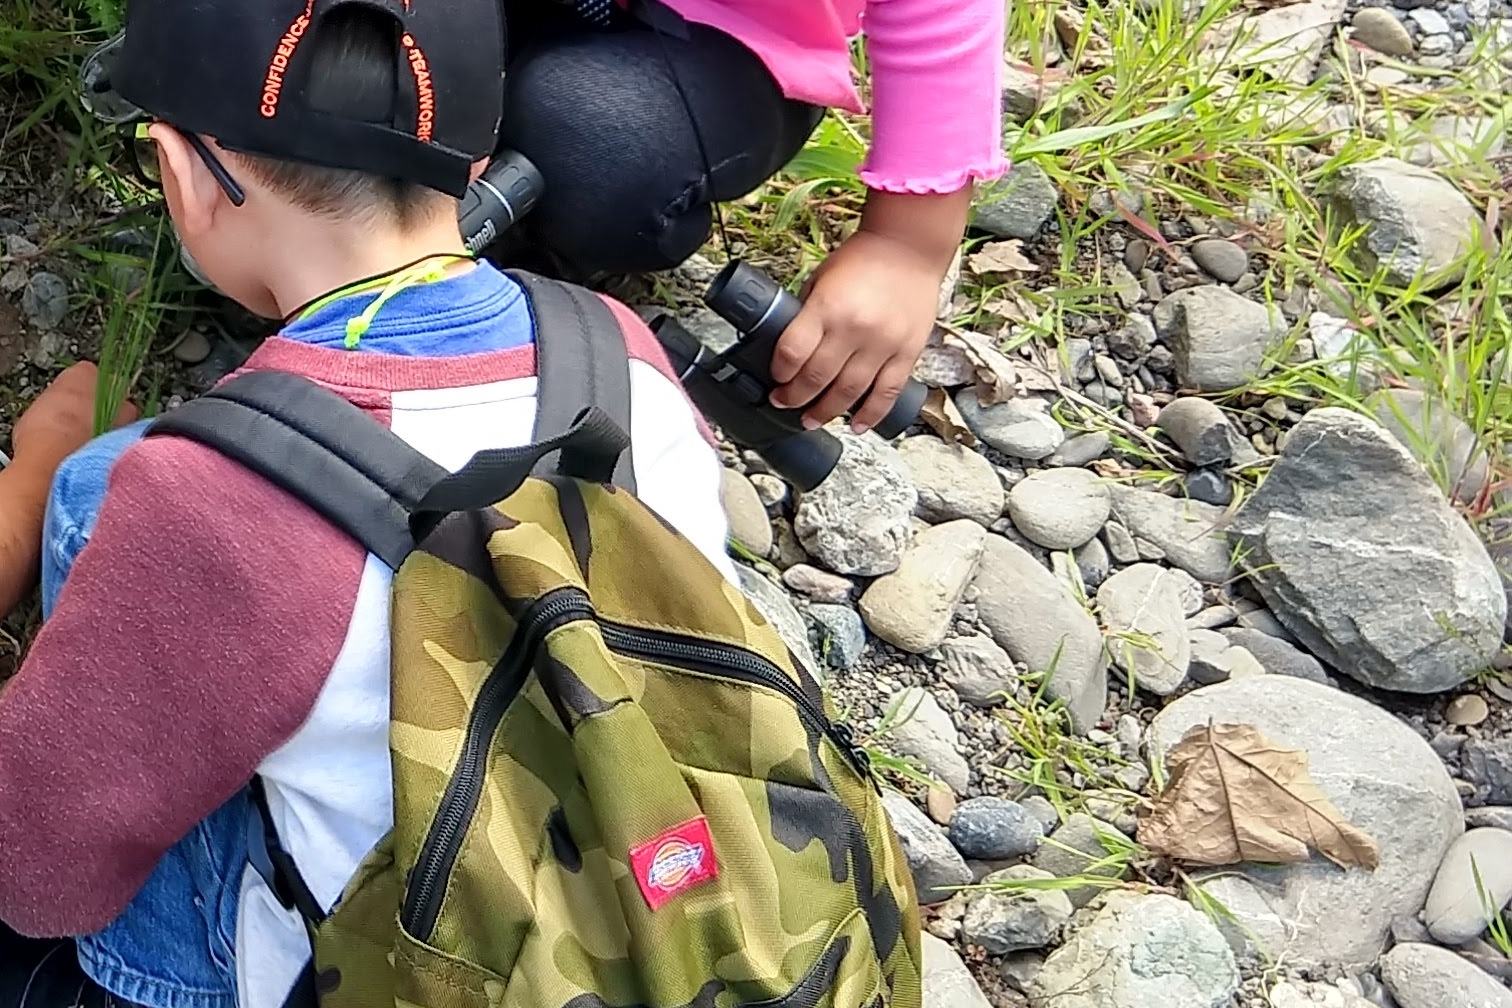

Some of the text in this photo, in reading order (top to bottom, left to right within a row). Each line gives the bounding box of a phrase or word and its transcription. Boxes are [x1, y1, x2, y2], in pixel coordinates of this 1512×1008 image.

[261, 15, 309, 117] CONFIDENCE
[409, 49, 433, 142] TEAMWORK
[464, 218, 497, 253] hnell
